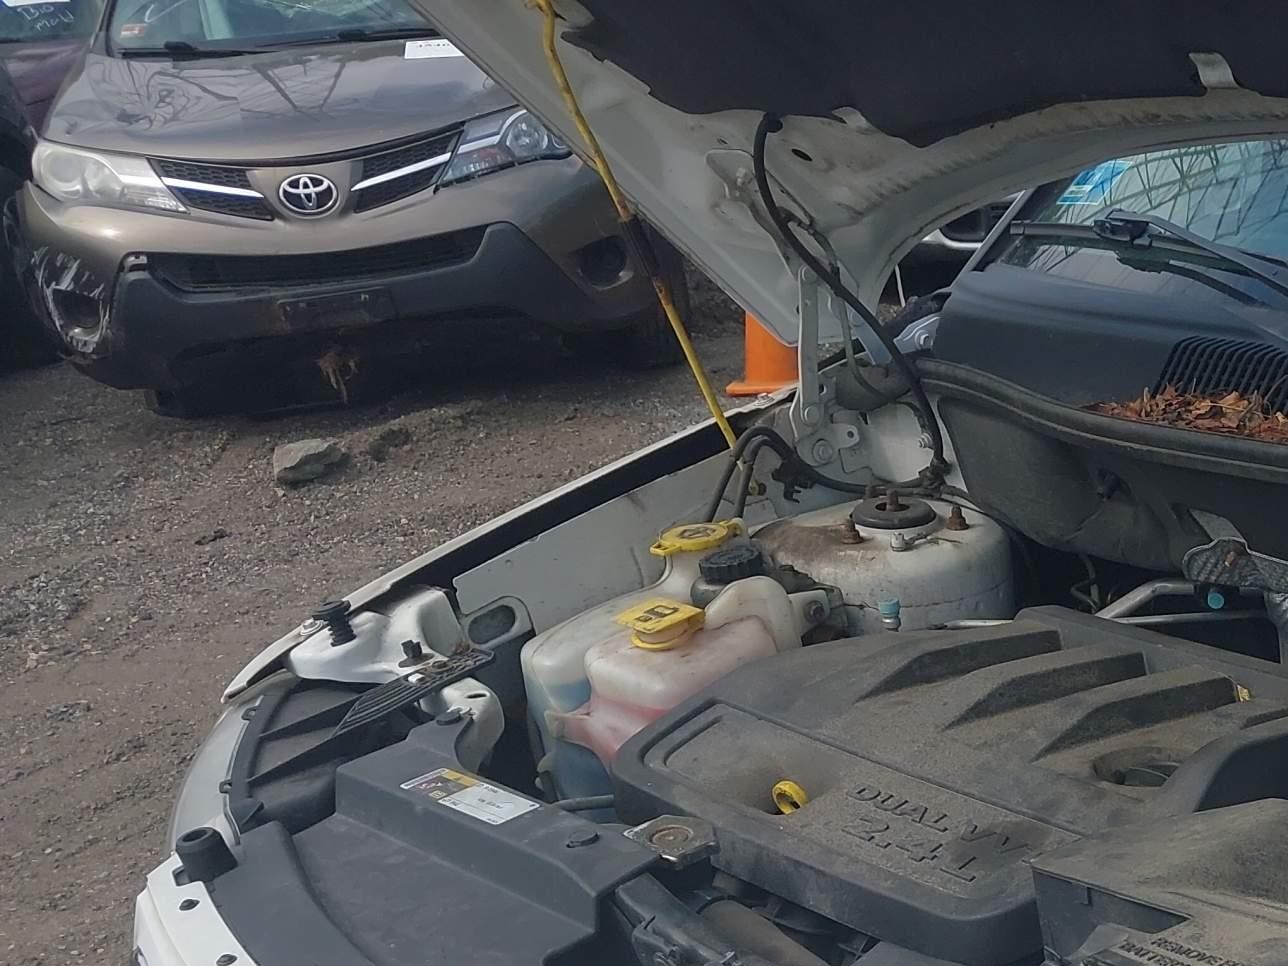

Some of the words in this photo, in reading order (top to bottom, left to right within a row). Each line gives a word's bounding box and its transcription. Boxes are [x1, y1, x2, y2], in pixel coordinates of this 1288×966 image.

[847, 784, 949, 833] DUAL
[841, 817, 977, 883] 2.4L
[1150, 937, 1223, 966] REMOVE
